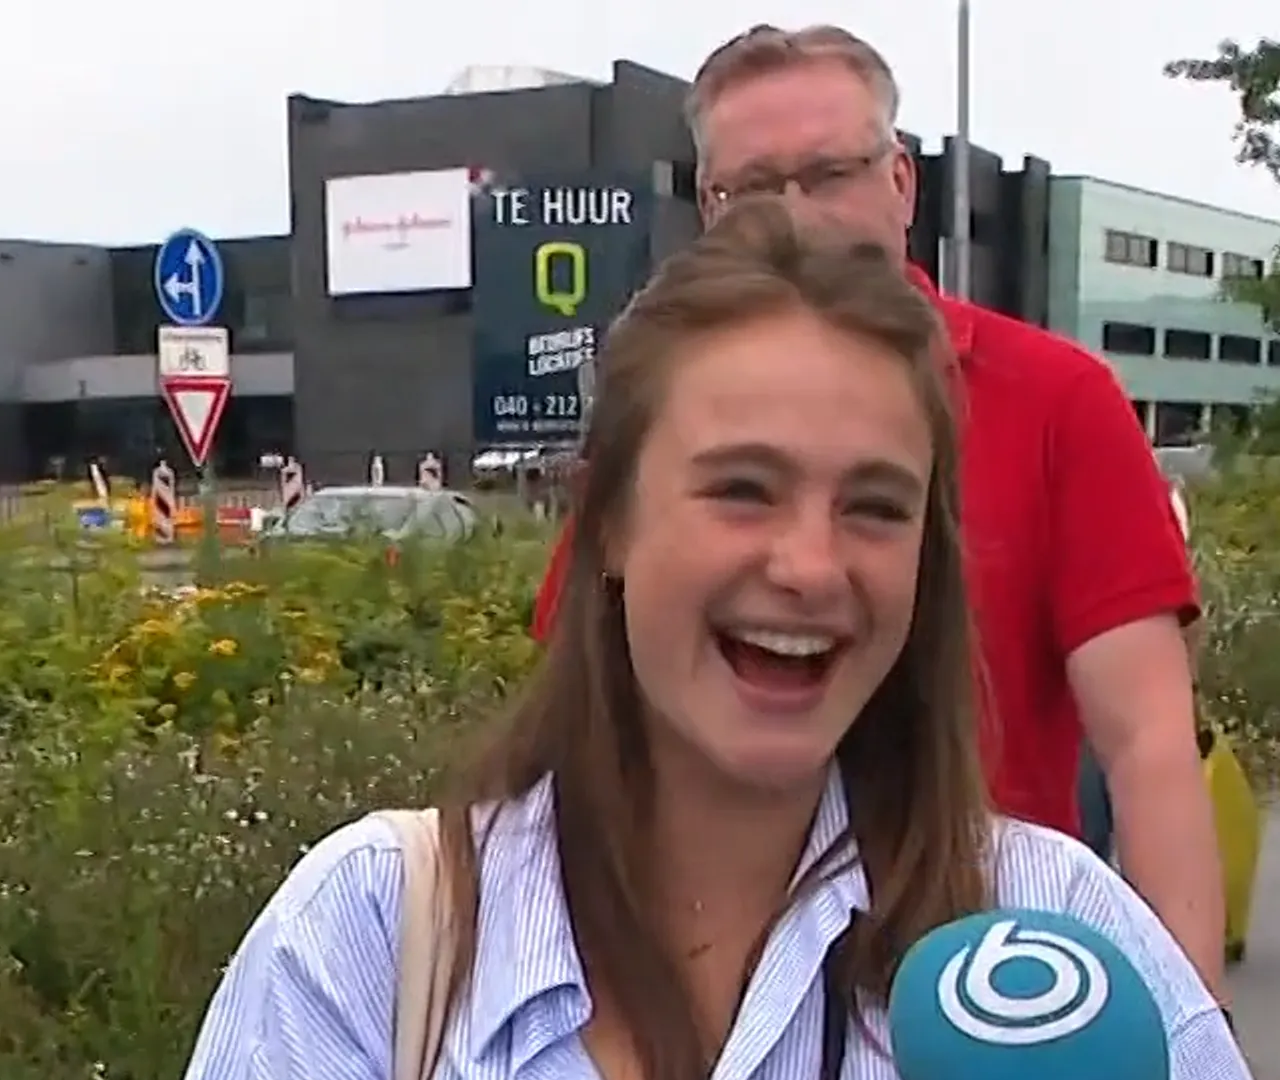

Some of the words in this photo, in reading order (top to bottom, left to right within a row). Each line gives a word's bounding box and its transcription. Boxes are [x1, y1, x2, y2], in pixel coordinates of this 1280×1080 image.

[491, 188, 530, 224] TE
[543, 188, 632, 224] HUUR
[536, 242, 585, 316] Q
[937, 920, 1109, 1045] 6
